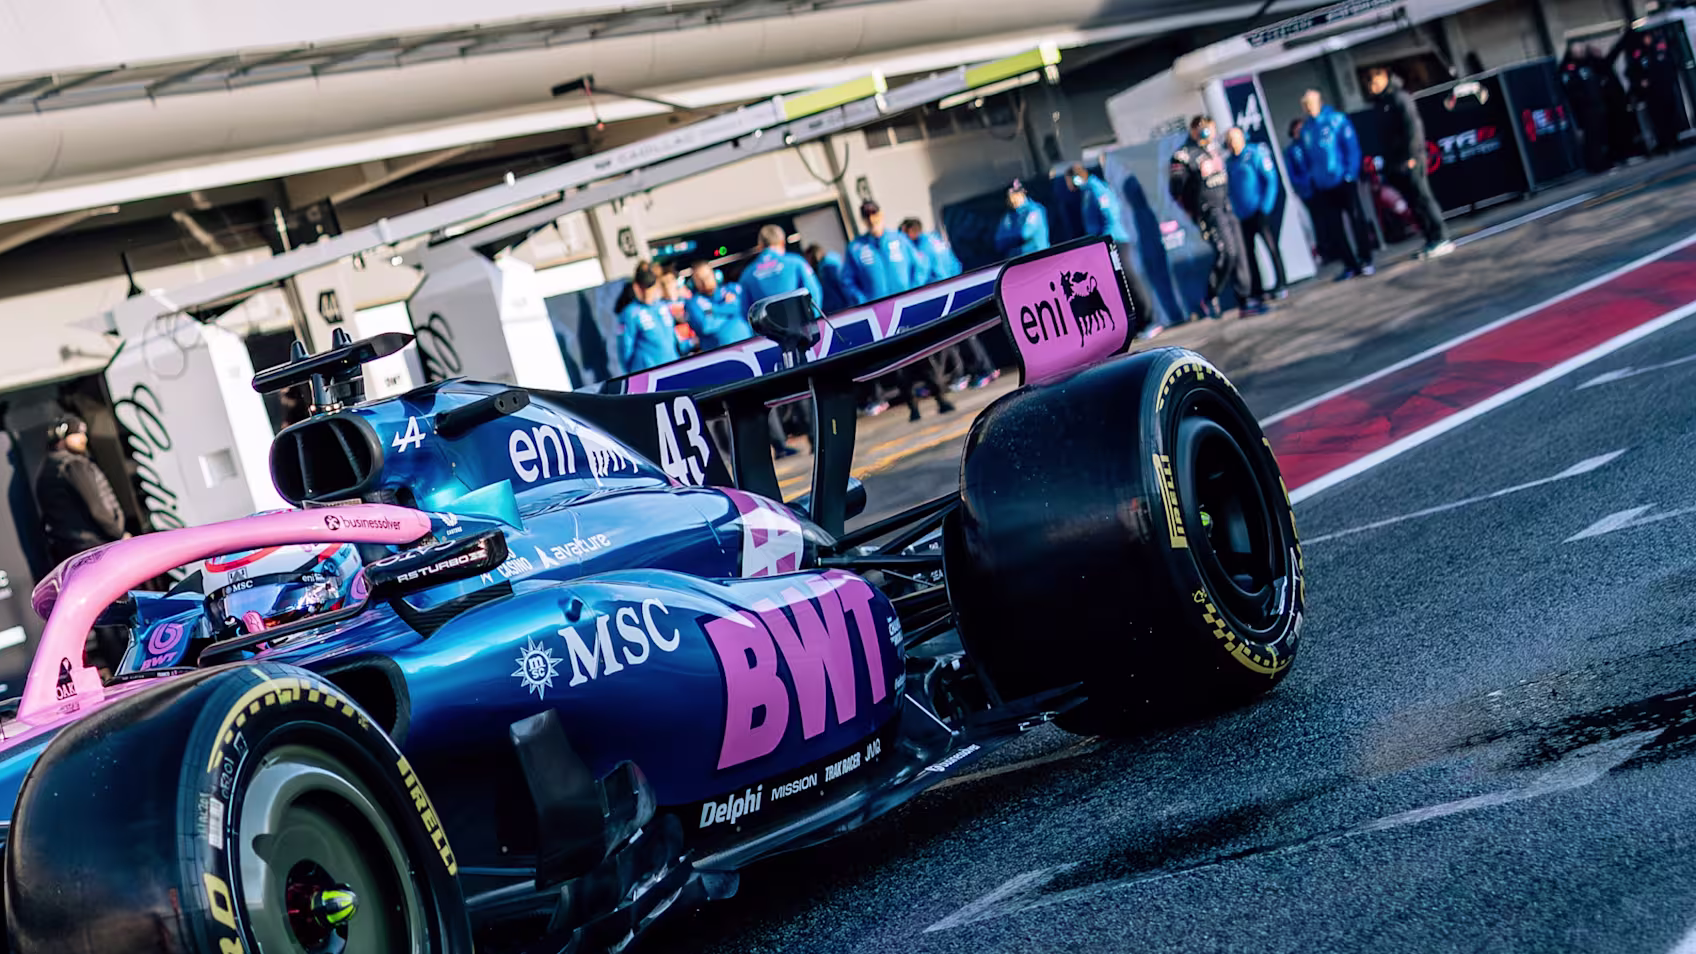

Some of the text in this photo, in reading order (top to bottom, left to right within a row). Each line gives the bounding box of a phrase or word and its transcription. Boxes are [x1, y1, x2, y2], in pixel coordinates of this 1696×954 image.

[1020, 281, 1069, 345] eni
[509, 424, 577, 483] eni
[656, 395, 710, 487] 43
[340, 514, 401, 531] businessolver
[1152, 453, 1190, 549] PIRELLI
[496, 556, 533, 578] CASINO
[553, 532, 611, 560] avature
[232, 579, 253, 593] MSC
[557, 597, 681, 688] MSC
[703, 567, 888, 771] BWT
[699, 784, 764, 829] Delphi
[770, 773, 818, 802] MISSION
